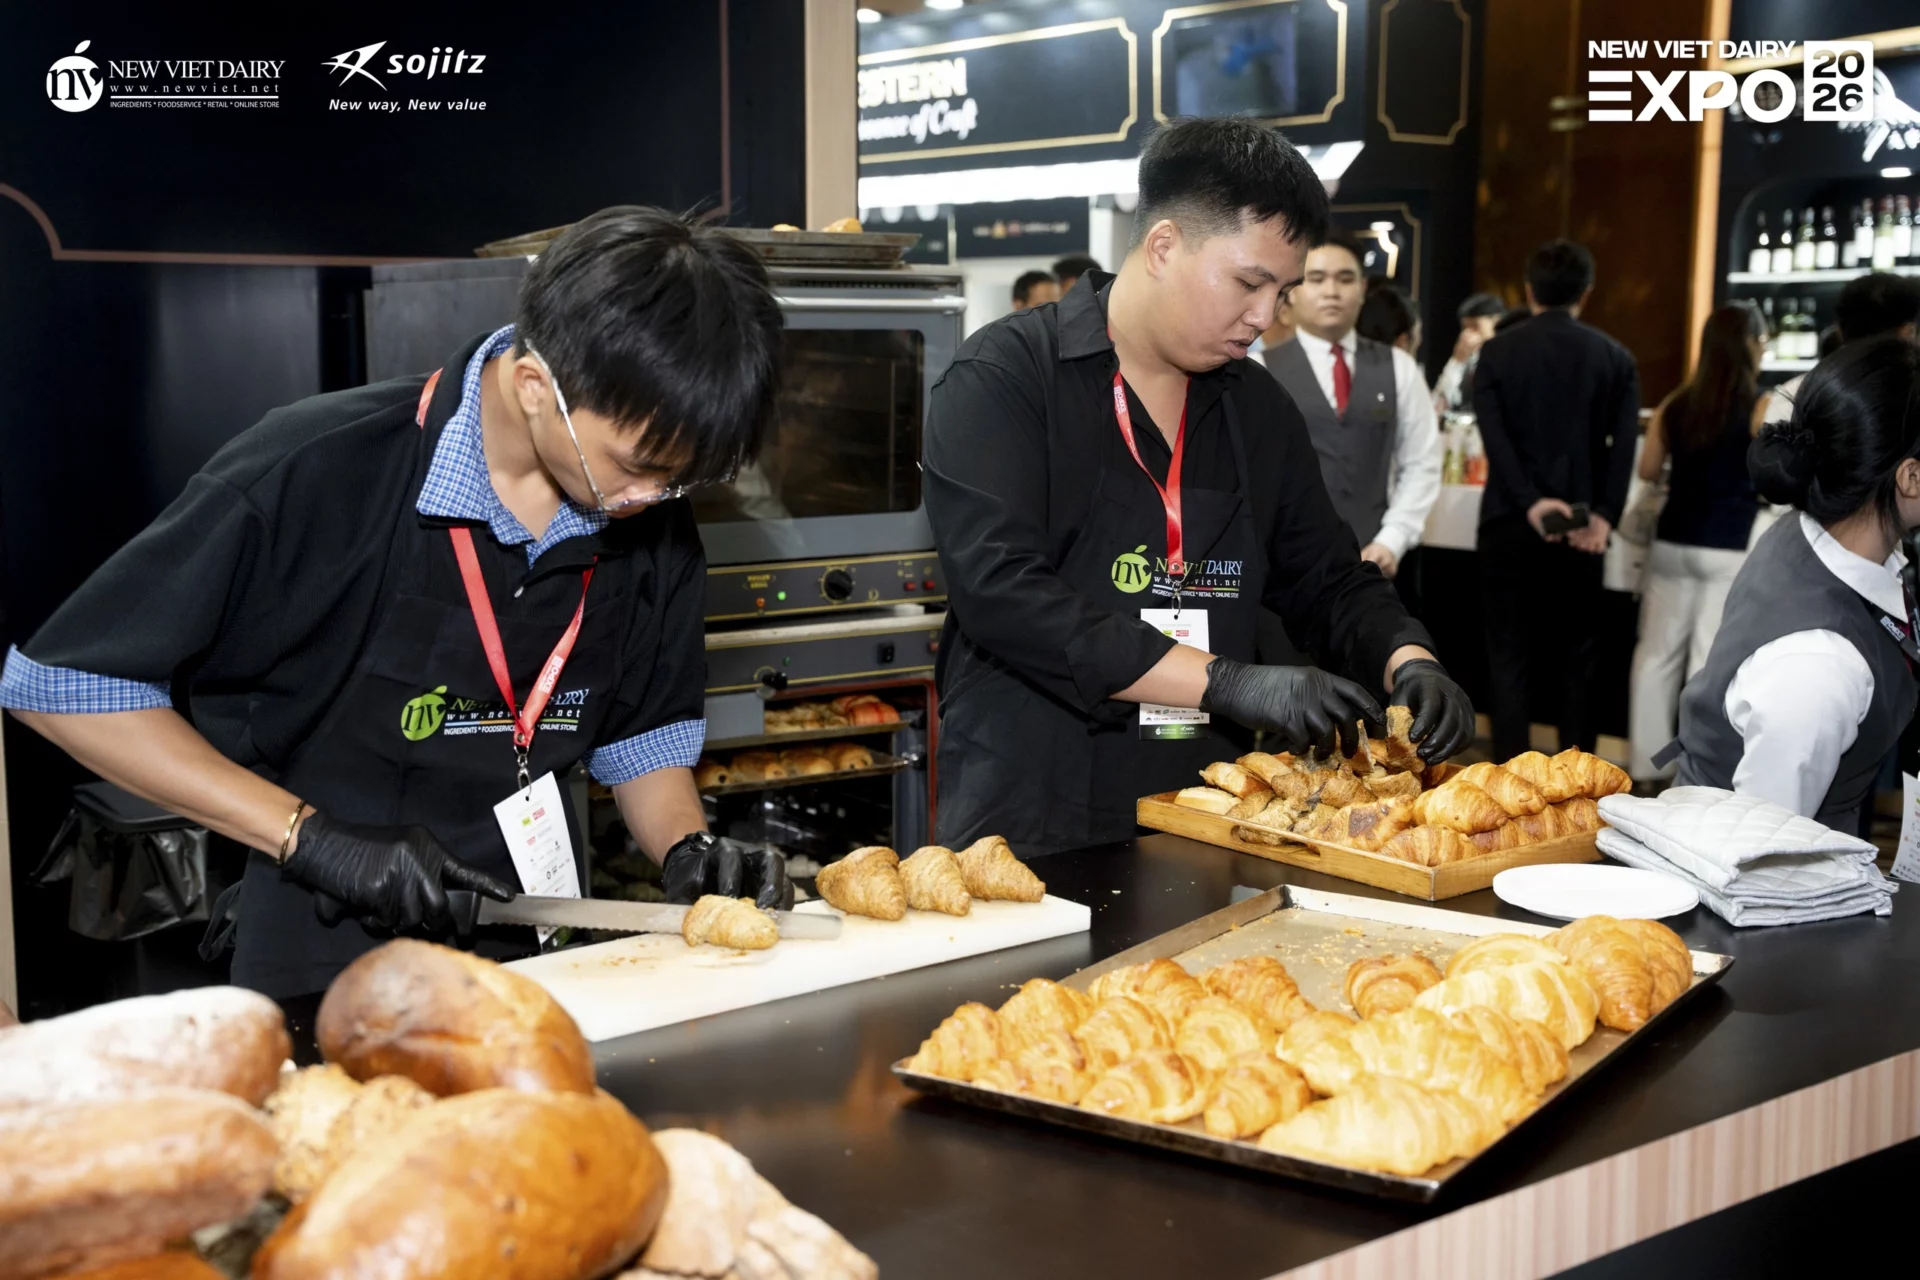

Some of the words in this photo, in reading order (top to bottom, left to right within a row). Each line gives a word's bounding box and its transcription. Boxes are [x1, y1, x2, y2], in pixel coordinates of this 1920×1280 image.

[1205, 560, 1243, 576] DAIRY
[444, 726, 478, 735] INGREDIENTS
[540, 723, 560, 731] ONLINE
[559, 724, 578, 732] STORE
